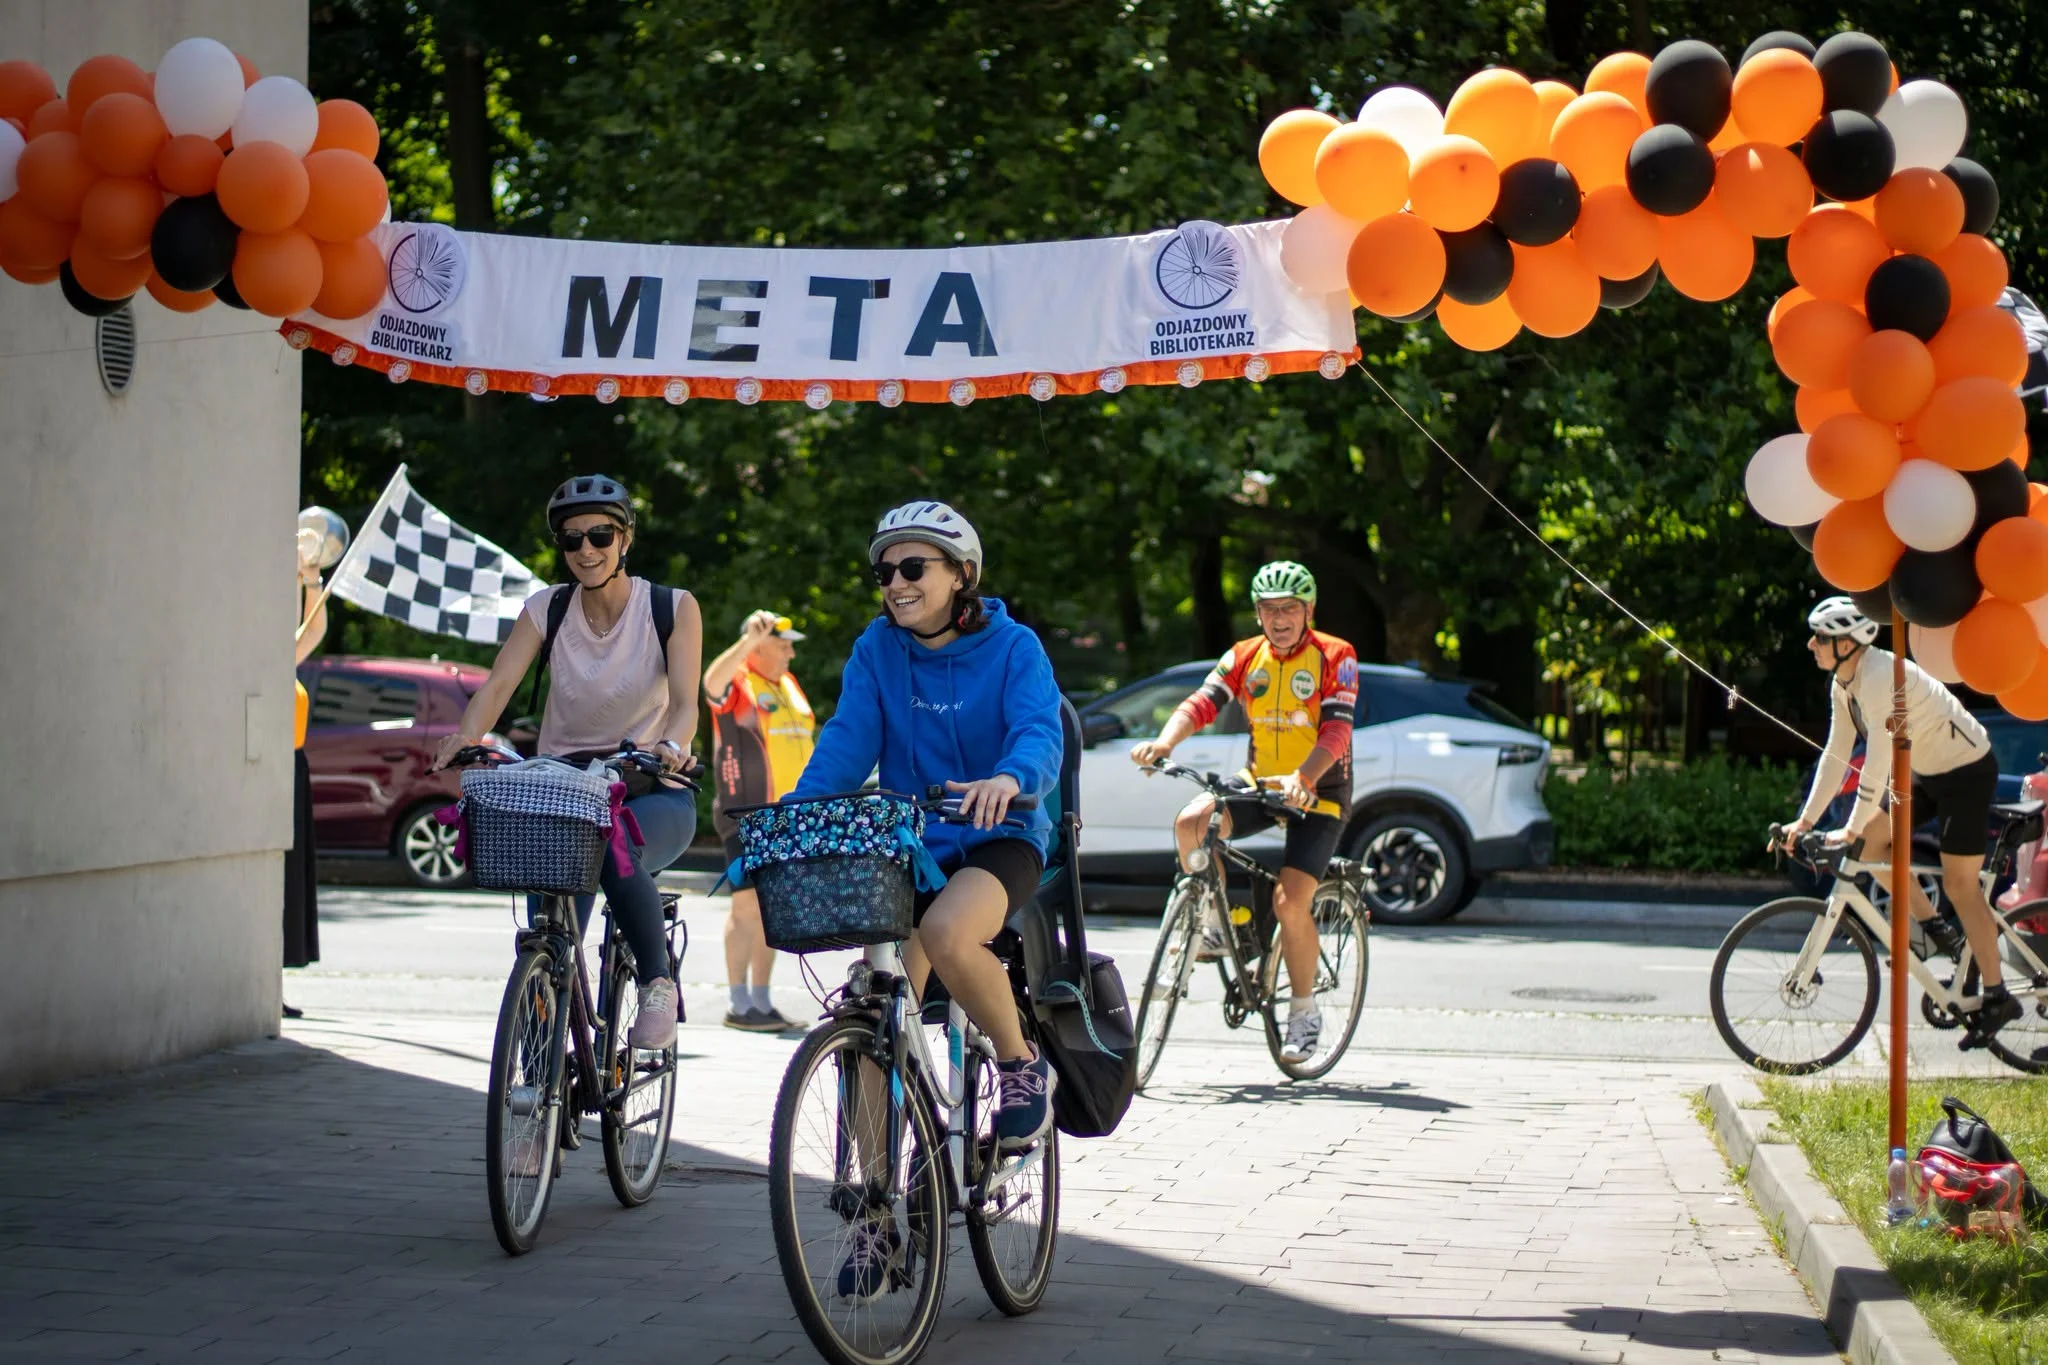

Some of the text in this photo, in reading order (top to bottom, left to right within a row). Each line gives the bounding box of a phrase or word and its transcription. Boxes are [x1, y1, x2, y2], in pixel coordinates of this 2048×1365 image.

[380, 314, 447, 343] ODJAZDOWY
[561, 271, 999, 362] META
[1155, 314, 1247, 337] ODJAZDOWY
[371, 330, 453, 361] BIBLIOTEKARZ
[1150, 331, 1255, 356] BIBLIOTEKARZ
